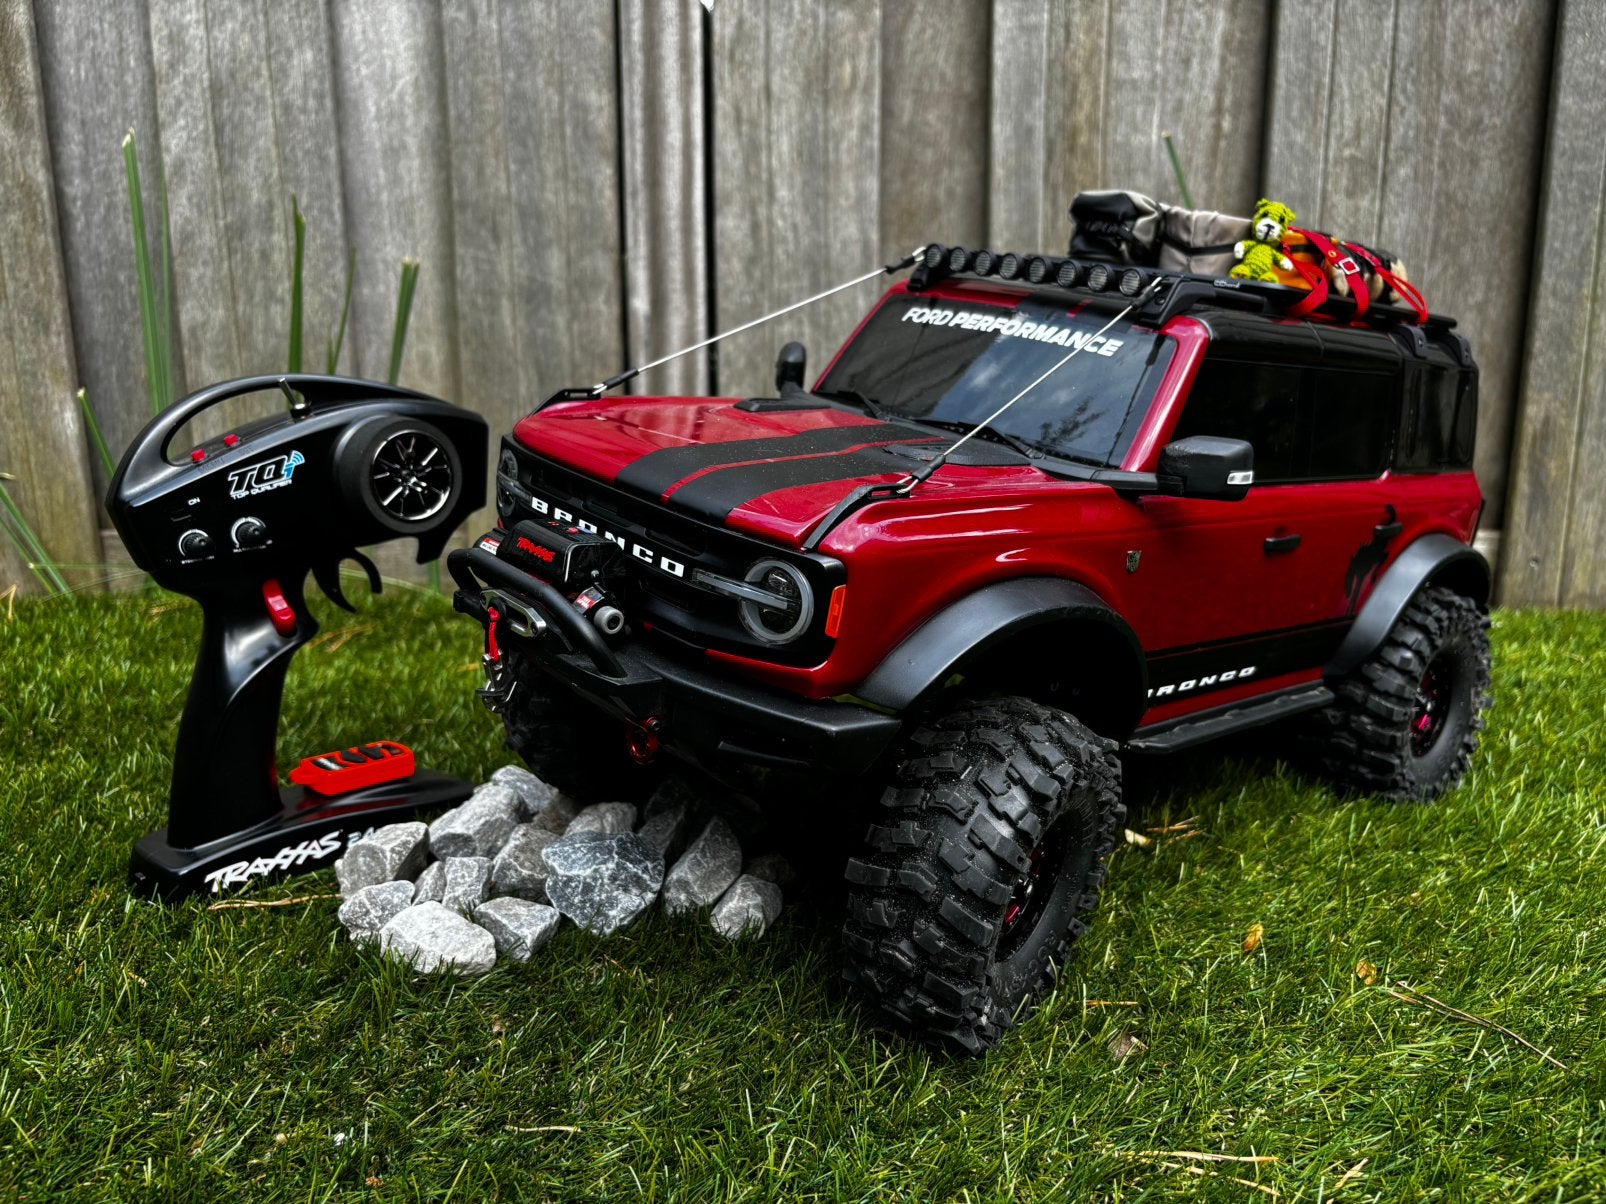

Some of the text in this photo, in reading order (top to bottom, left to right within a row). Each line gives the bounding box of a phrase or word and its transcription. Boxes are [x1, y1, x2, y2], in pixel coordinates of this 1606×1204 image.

[902, 307, 1124, 357] FORD PERFORMANCE
[188, 497, 201, 506] ON
[231, 487, 249, 499] TOP
[1147, 666, 1256, 699] RONCO
